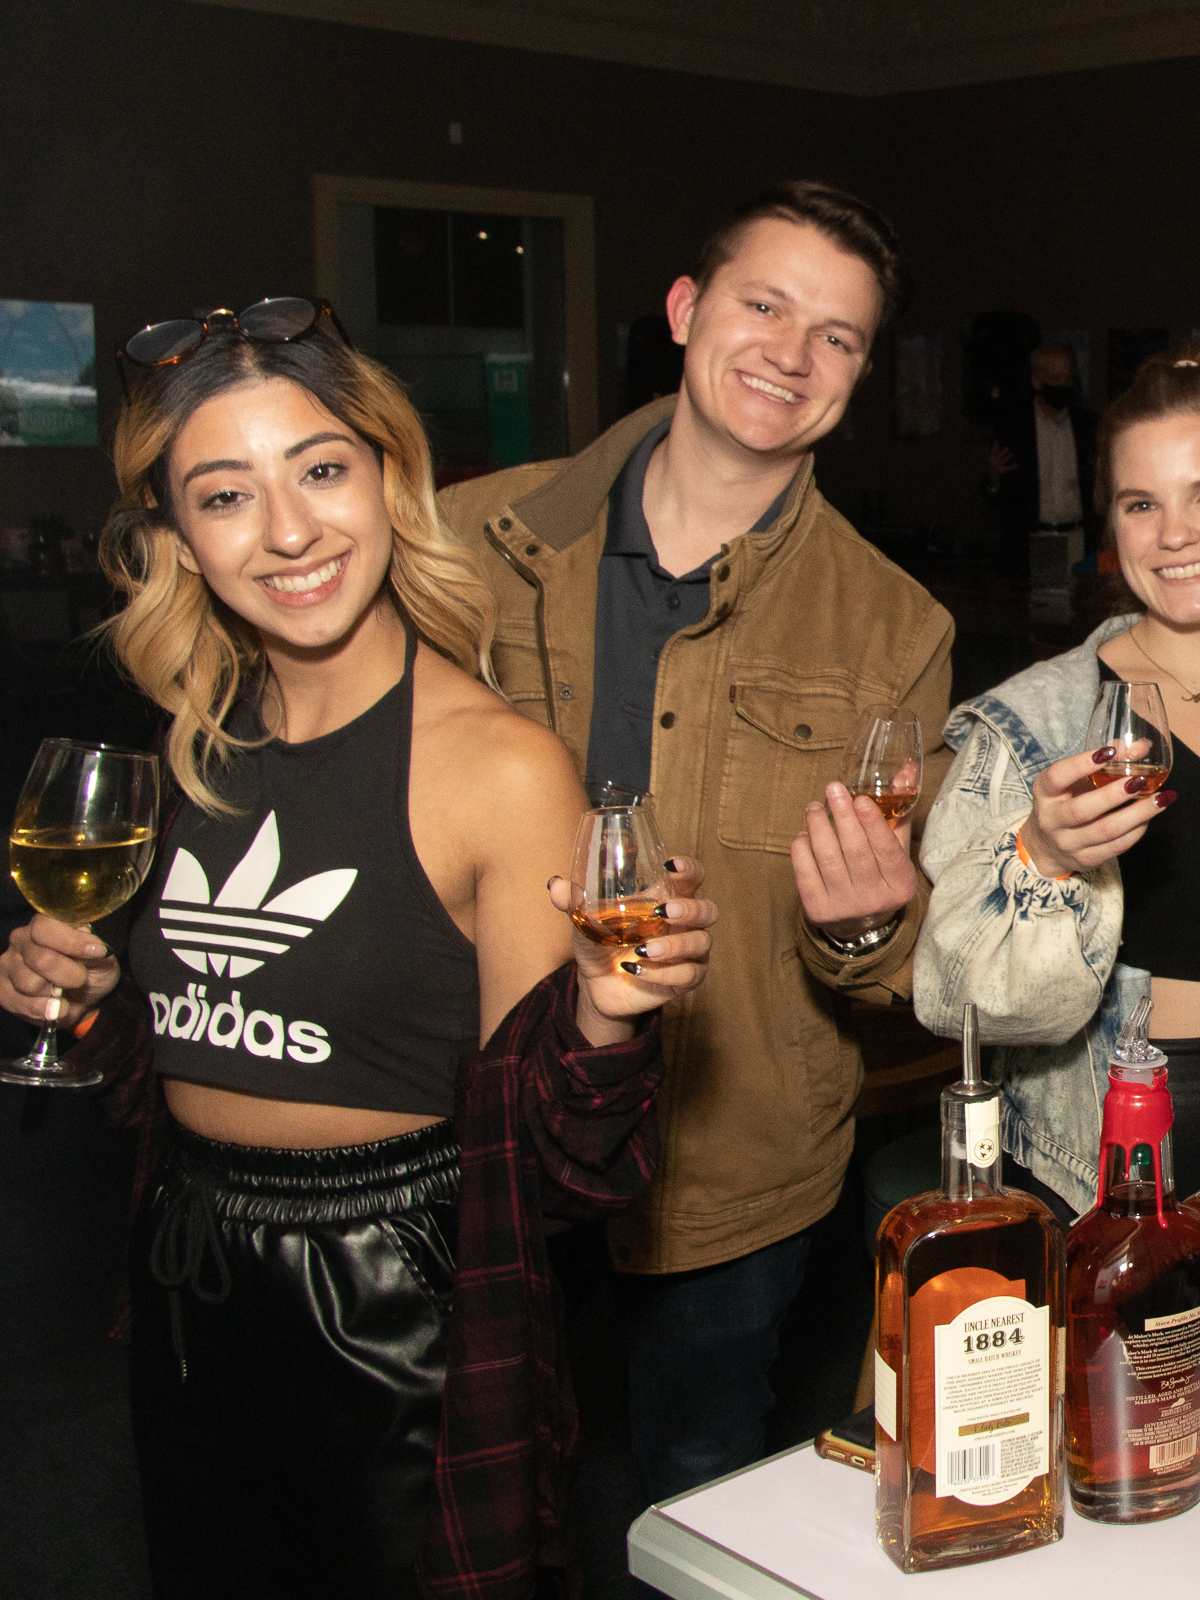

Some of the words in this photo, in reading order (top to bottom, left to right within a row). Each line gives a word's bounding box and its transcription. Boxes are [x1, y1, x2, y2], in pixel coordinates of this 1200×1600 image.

[149, 983, 332, 1064] adidas
[964, 1318, 989, 1333] UNCLE
[991, 1312, 1025, 1329] NEAREST
[963, 1327, 1025, 1354] 1884
[968, 1356, 984, 1365] SMALL
[984, 1353, 1000, 1363] BATCH
[1001, 1349, 1022, 1360] WHISKEY
